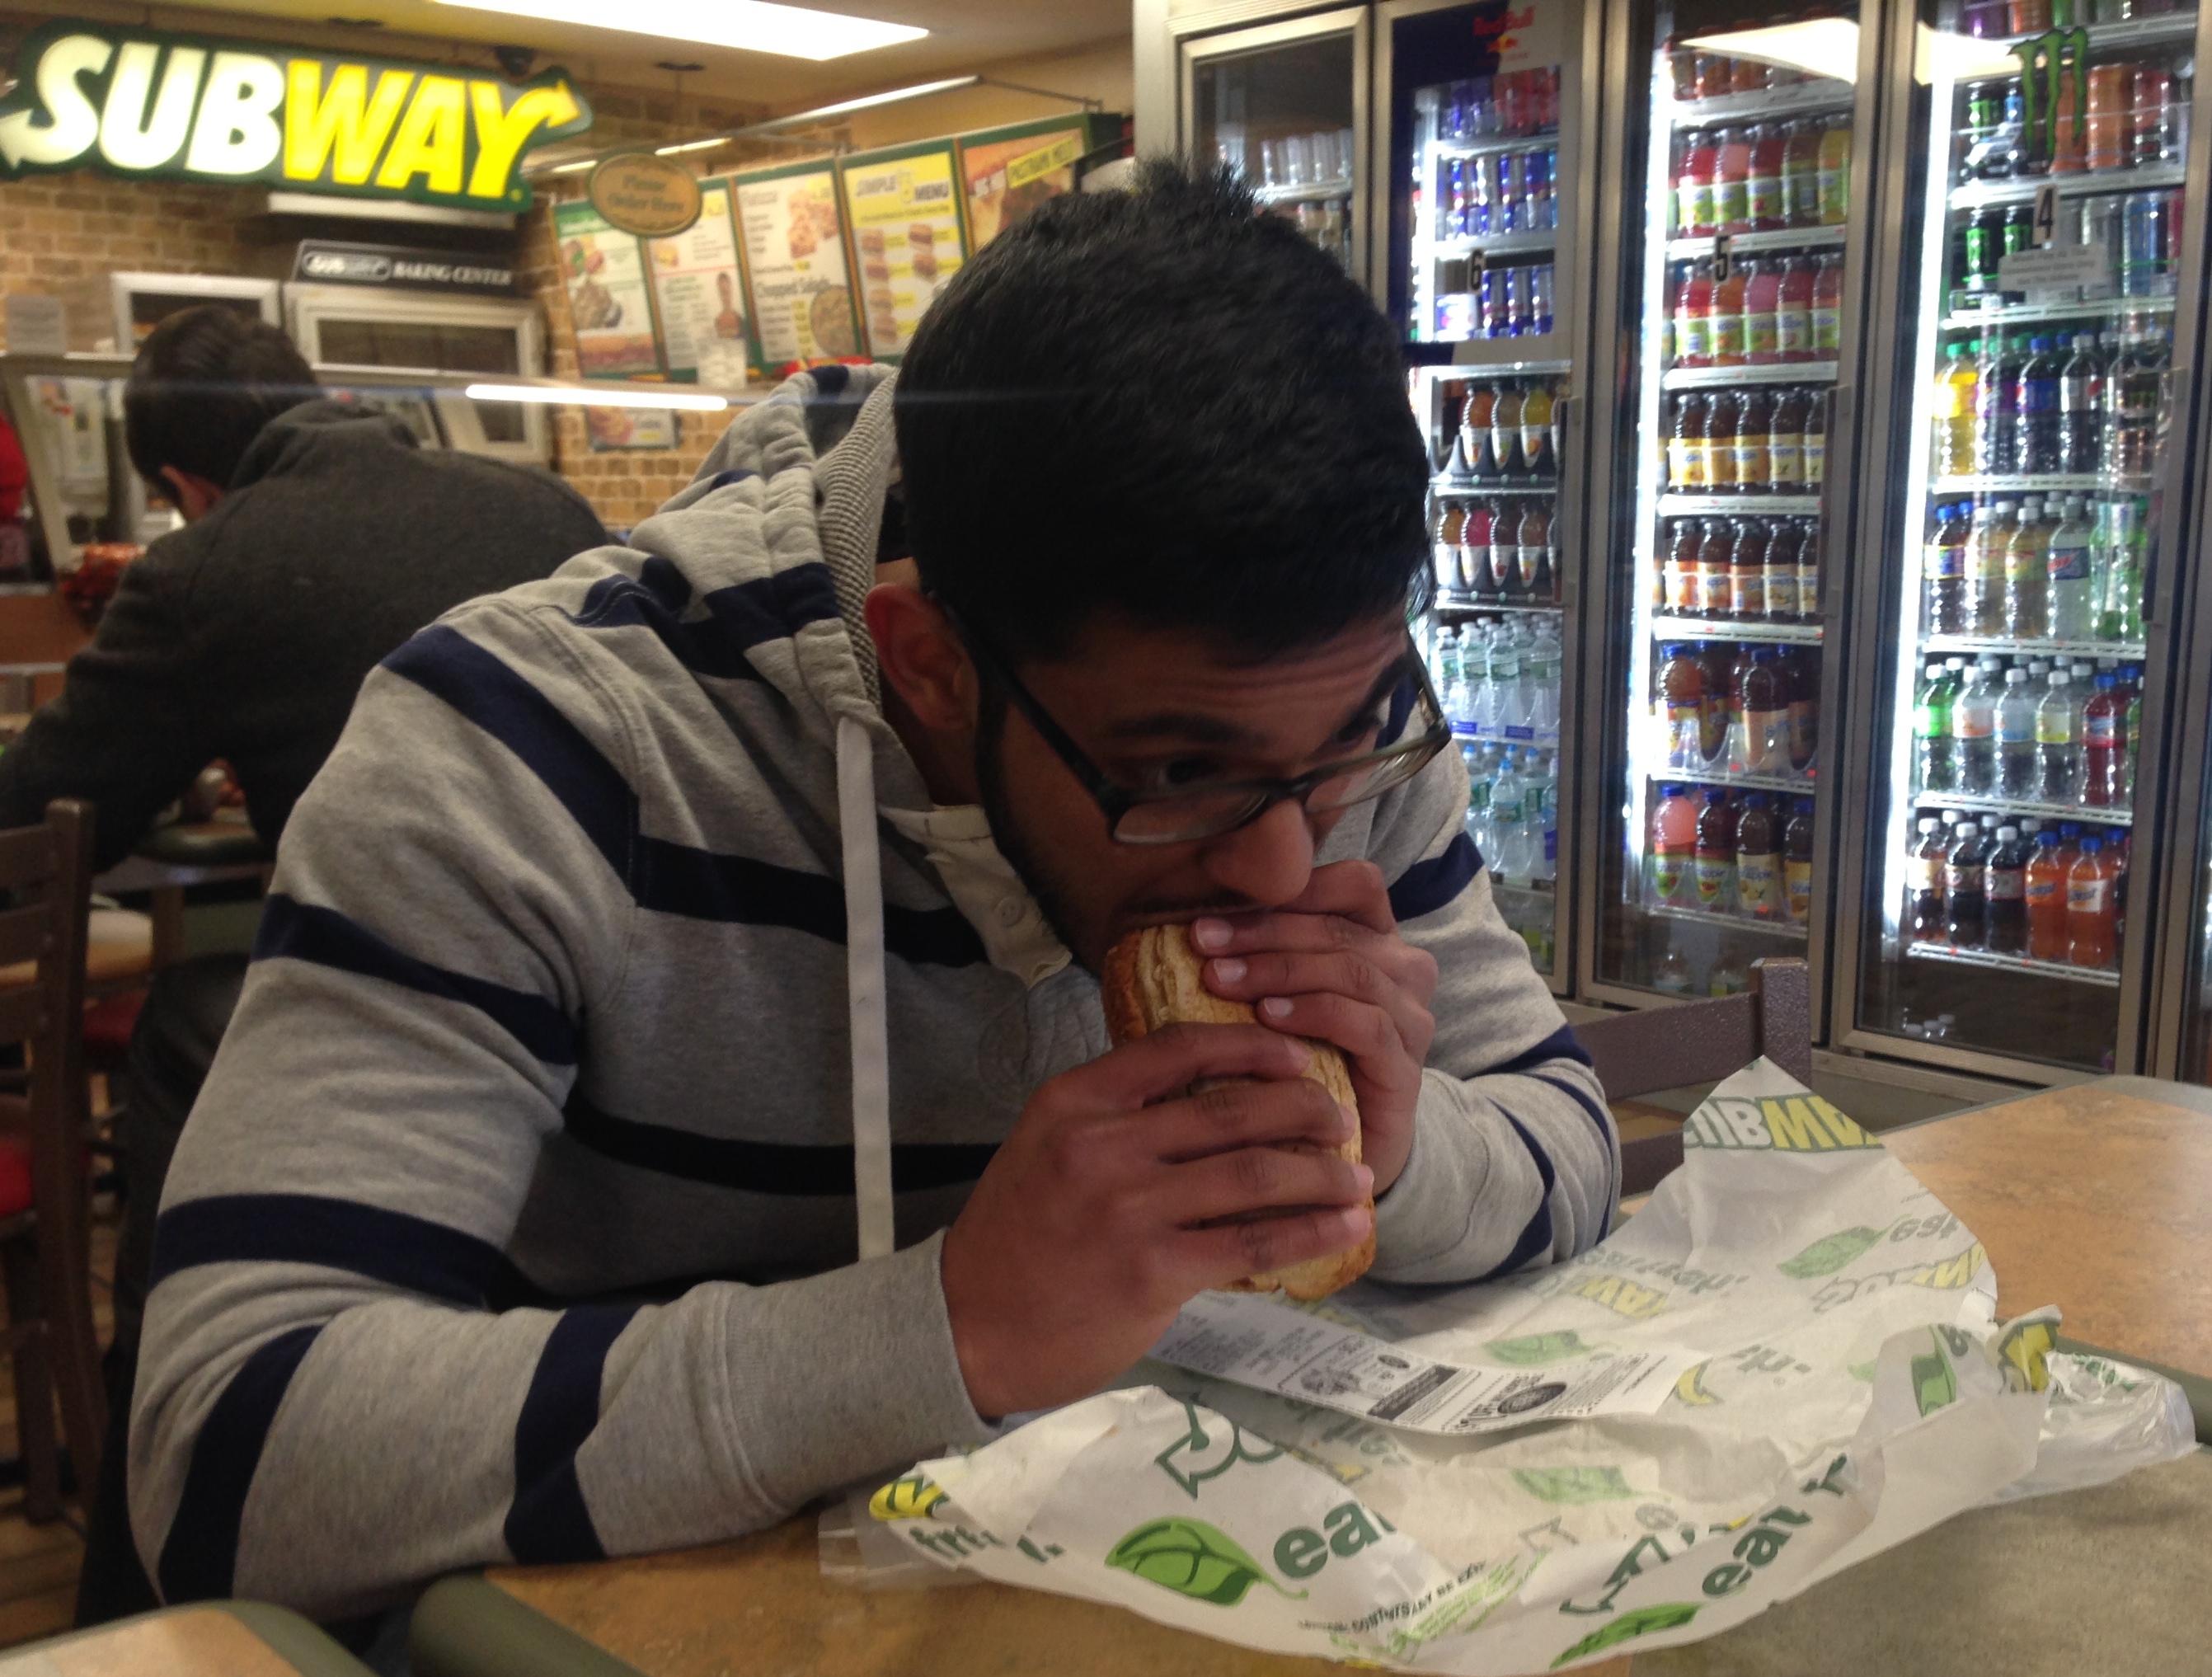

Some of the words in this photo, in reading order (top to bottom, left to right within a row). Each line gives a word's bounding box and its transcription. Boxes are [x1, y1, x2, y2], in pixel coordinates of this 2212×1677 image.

[0, 34, 580, 199] SUBWAY
[2037, 188, 2053, 239] 4
[1471, 250, 1482, 290] 6
[1716, 236, 1730, 281] 5
[1273, 1500, 1397, 1580] ea
